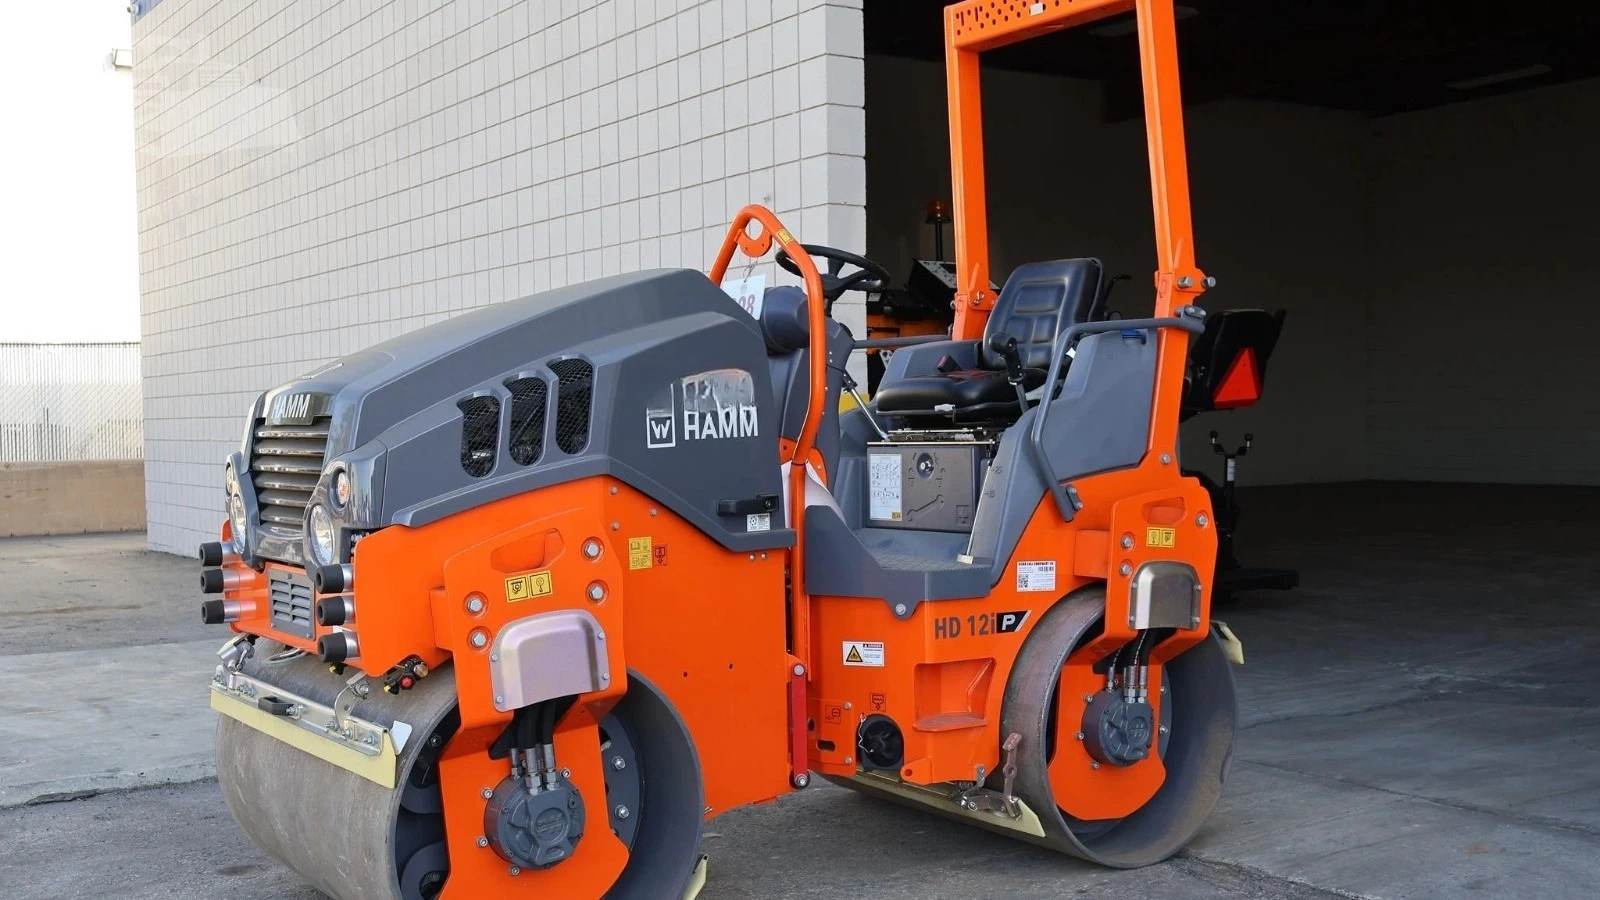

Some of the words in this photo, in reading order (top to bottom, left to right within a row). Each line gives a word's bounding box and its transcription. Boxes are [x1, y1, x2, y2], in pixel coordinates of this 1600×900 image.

[271, 393, 311, 419] HAMM
[683, 405, 759, 440] HAMM
[934, 616, 961, 640] HD
